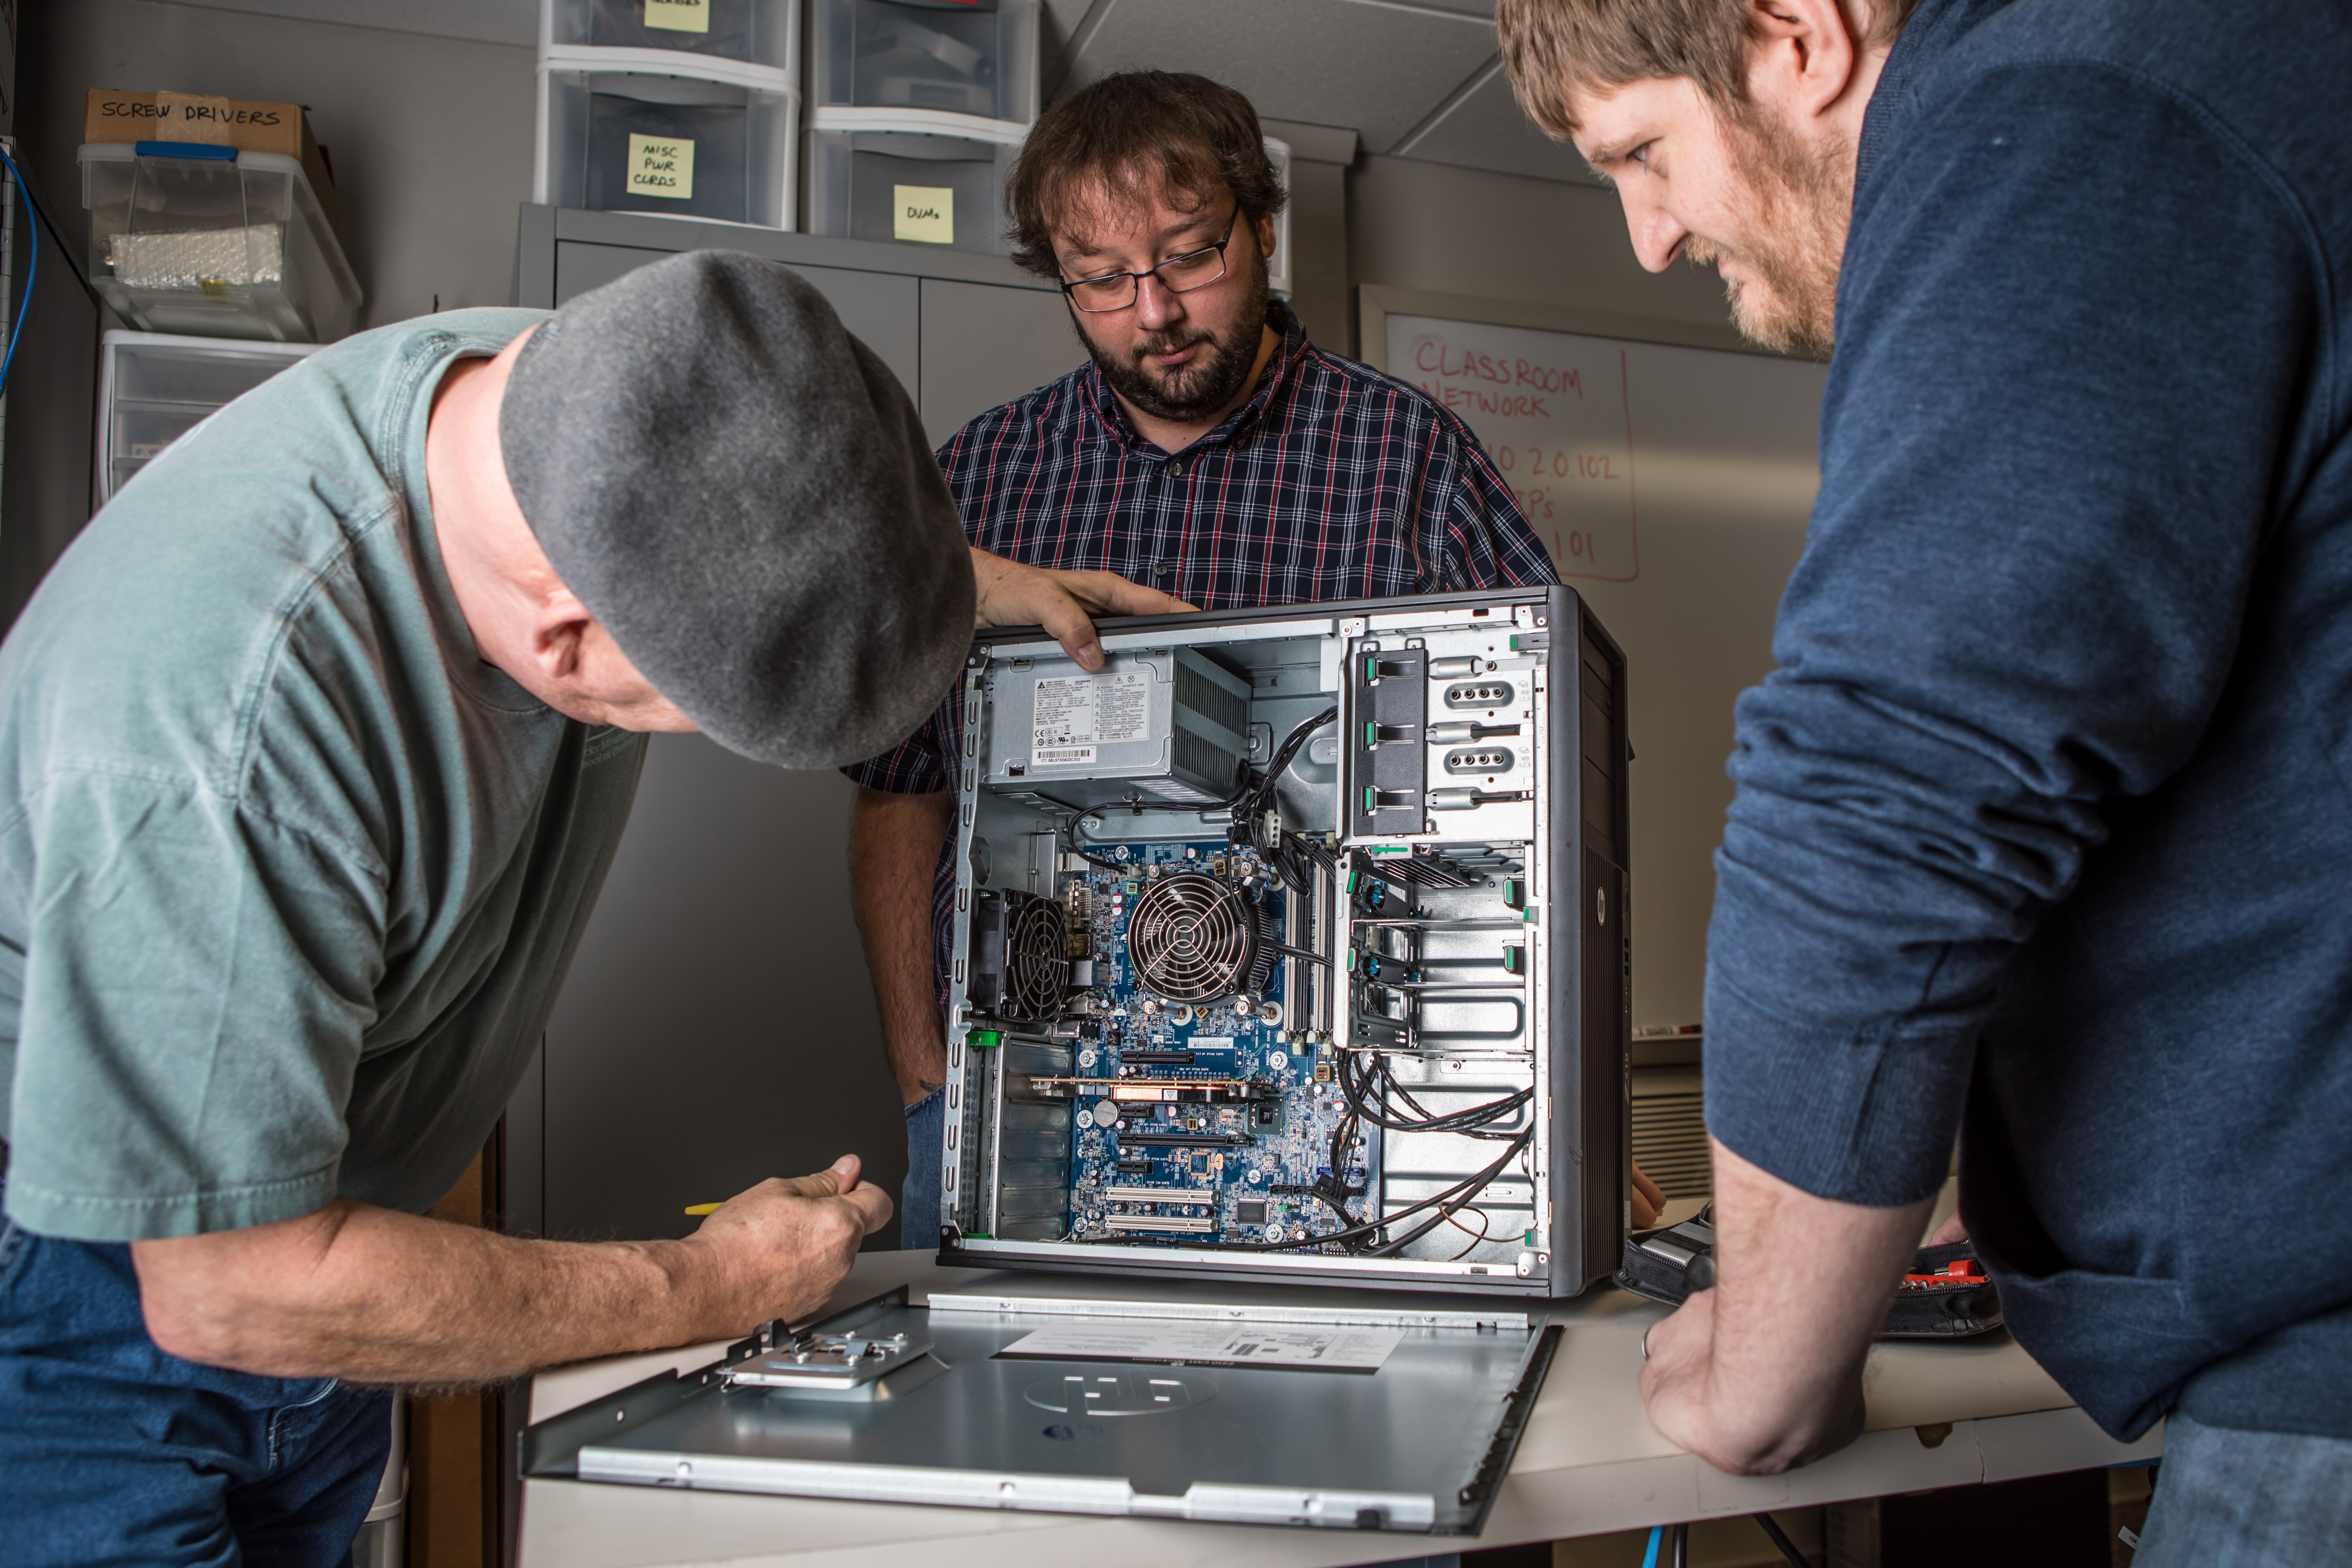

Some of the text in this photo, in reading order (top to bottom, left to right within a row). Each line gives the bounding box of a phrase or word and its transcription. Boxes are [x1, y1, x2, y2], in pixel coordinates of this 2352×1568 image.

[102, 101, 281, 126] SCREW DRIVERS
[643, 145, 678, 158] MISC
[644, 157, 675, 172] PWR
[1416, 341, 1583, 400] CLASSROOM
[1248, 1171, 1261, 1182] hp
